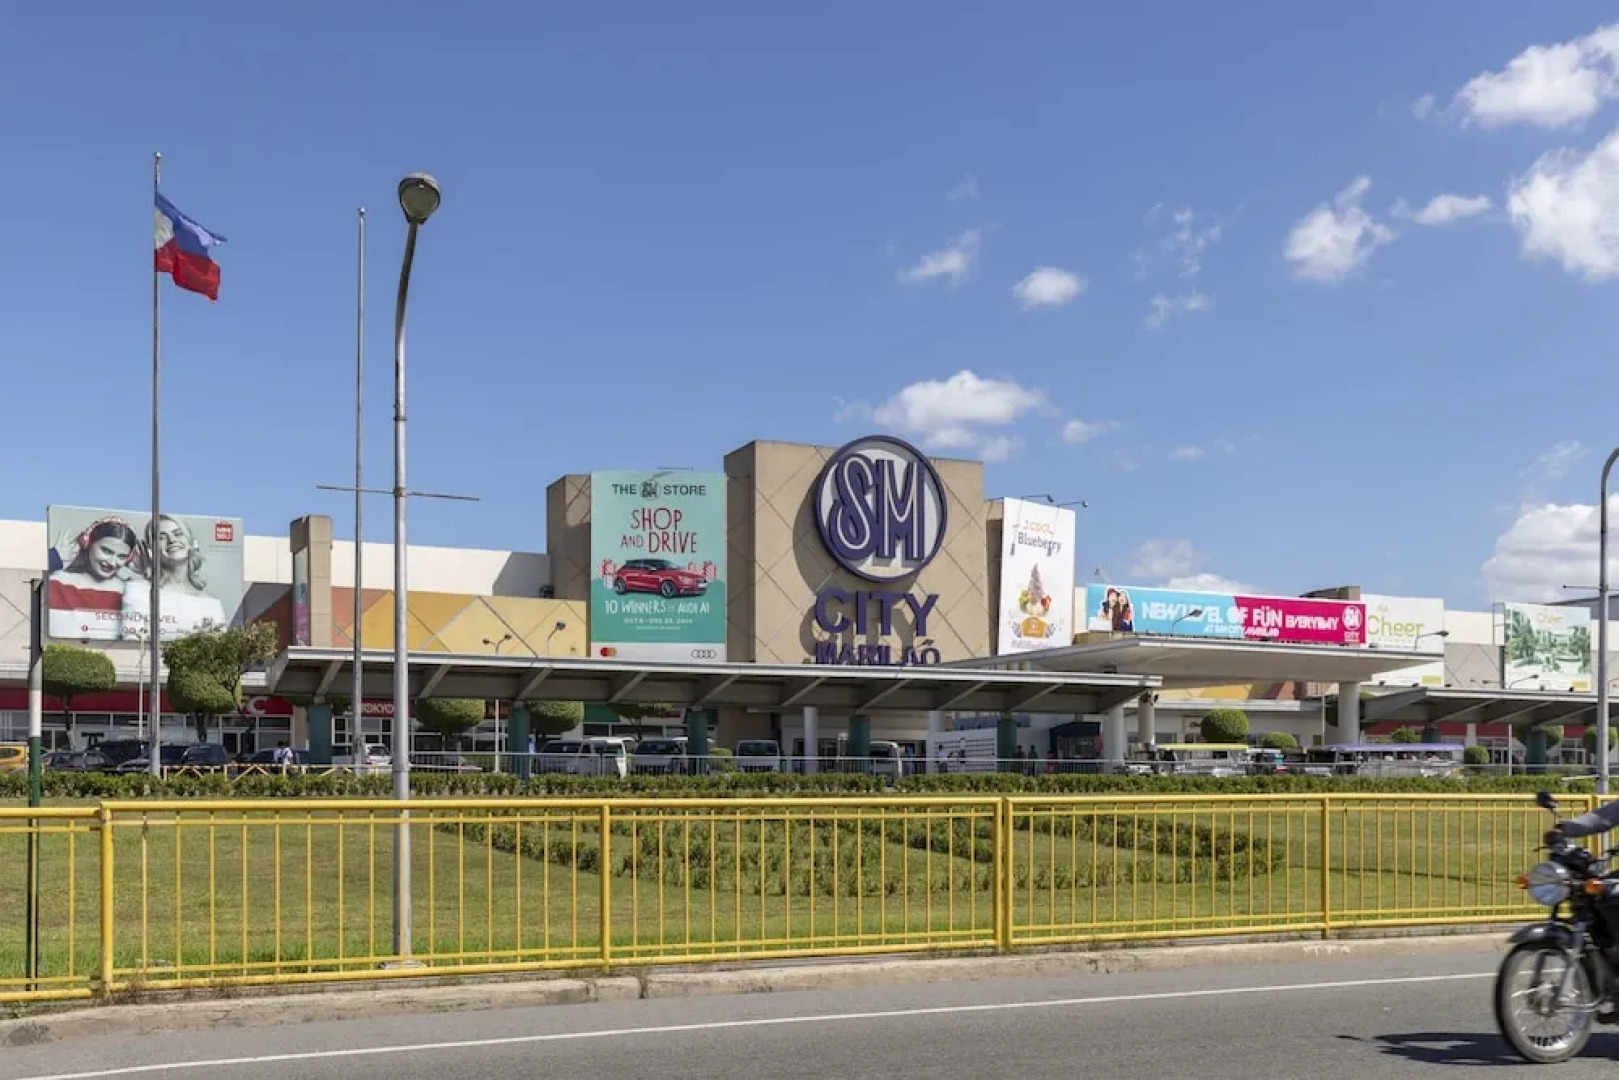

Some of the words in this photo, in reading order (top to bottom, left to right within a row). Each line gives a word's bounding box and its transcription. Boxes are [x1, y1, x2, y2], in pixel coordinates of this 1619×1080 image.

[612, 483, 637, 495] THE
[663, 485, 706, 496] STORE
[829, 453, 925, 560] SM
[630, 507, 682, 531] SHOP
[621, 534, 644, 548] AND
[648, 531, 697, 554] DRIVE
[95, 611, 142, 622] SECOND
[145, 613, 178, 624] LVEL
[605, 600, 618, 614] 10
[621, 600, 666, 614] WINNERS
[816, 588, 939, 636] CITY
[1141, 601, 1181, 620] NEW
[1368, 614, 1425, 636] Cheer
